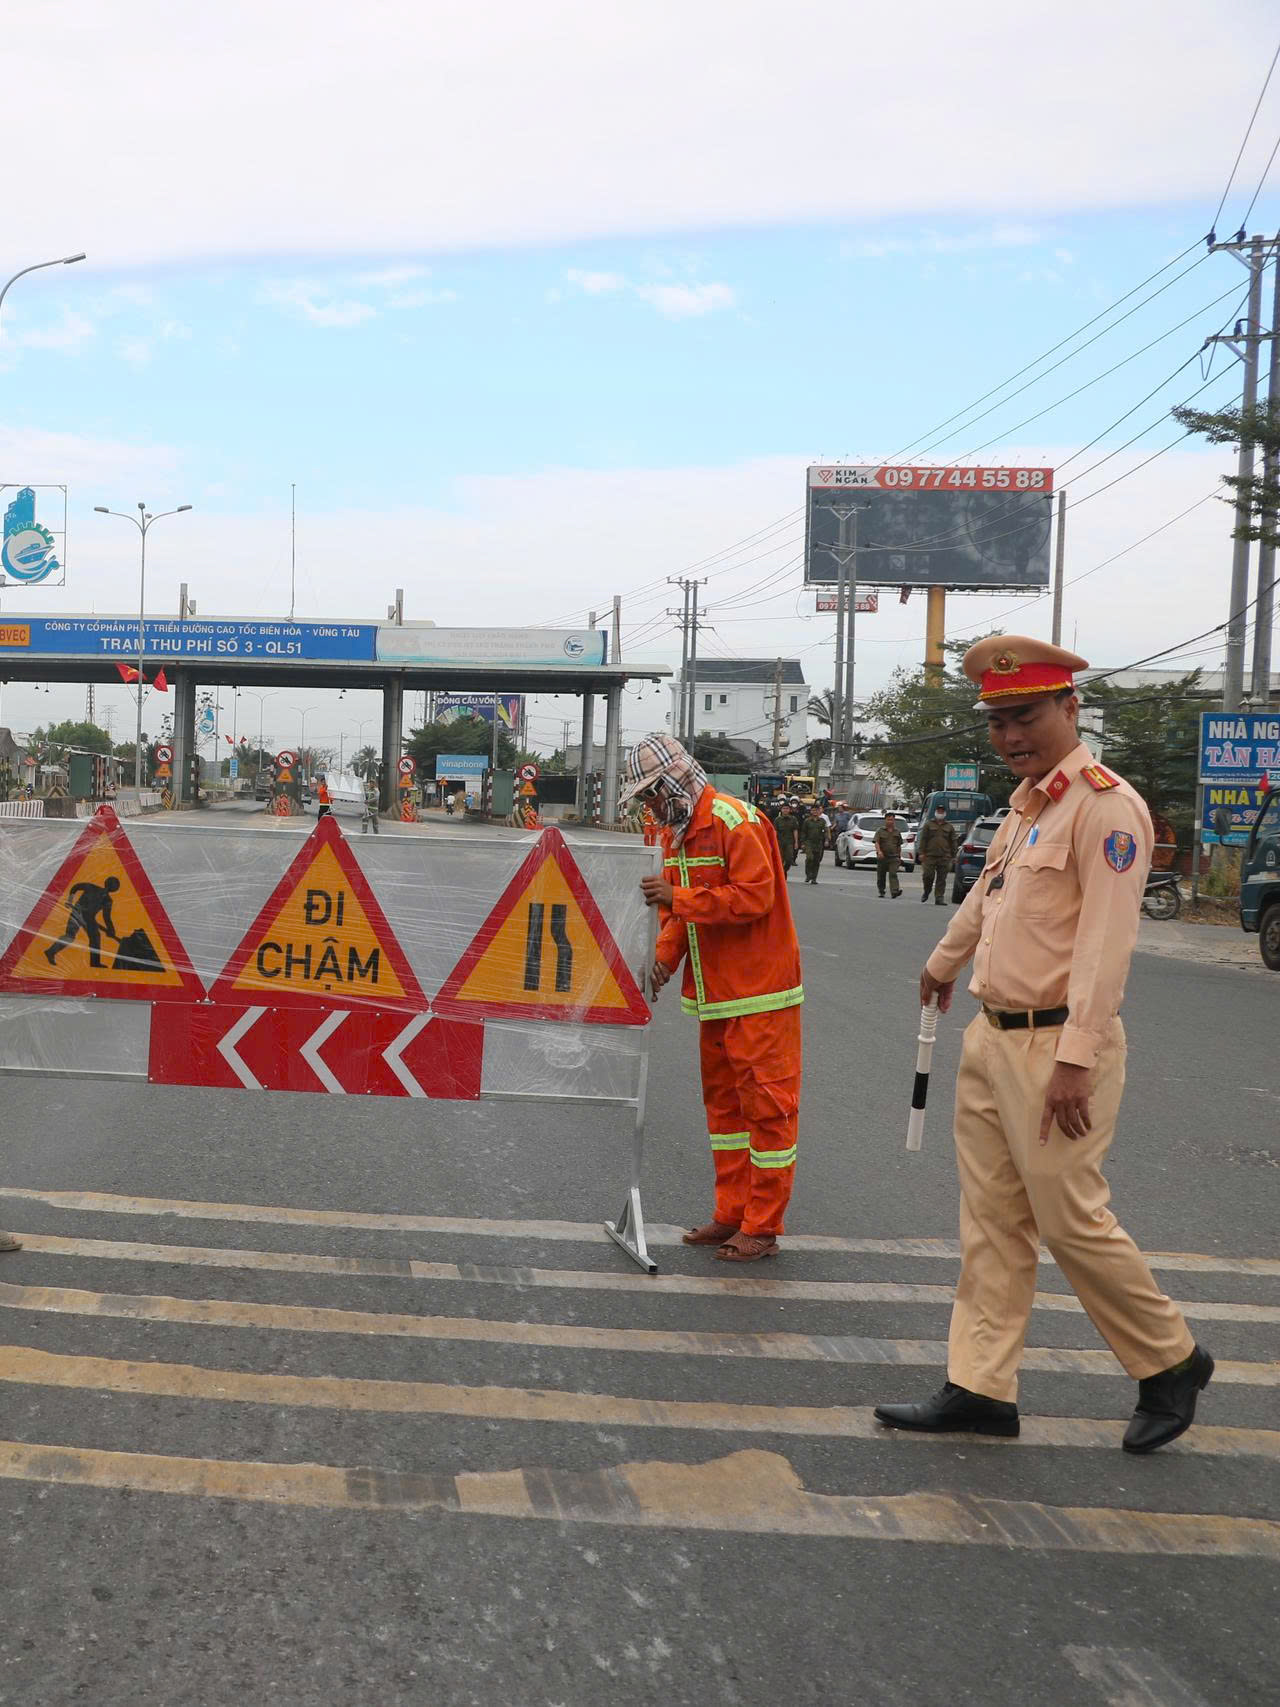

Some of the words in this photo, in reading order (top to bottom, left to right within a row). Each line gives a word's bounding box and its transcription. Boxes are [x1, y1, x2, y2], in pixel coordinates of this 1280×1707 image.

[884, 470, 913, 486] 09
[917, 470, 942, 487] 77
[948, 470, 976, 488] 44
[982, 470, 1010, 488] 55
[1016, 471, 1045, 488] 88
[0, 629, 26, 642] BVEC
[45, 622, 70, 631] CÔNG
[153, 621, 180, 633] TRIỂN
[182, 624, 214, 634] ĐƯỜNG
[217, 626, 235, 634] CAO
[239, 623, 257, 635] TỐC
[260, 625, 280, 636] BIÊN
[312, 626, 338, 637] VŨNG
[341, 627, 360, 638] TÀU
[101, 638, 146, 652] TRẠM
[151, 639, 182, 651] THU
[186, 637, 212, 652] PHÍ
[217, 637, 238, 653] SỐ
[244, 642, 253, 653] 3
[266, 642, 302, 654] QL51
[1208, 718, 1248, 739] NHÀ
[1205, 741, 1252, 768] TÂN
[1210, 787, 1250, 805] NHÀ
[304, 889, 345, 926] ĐI
[256, 936, 380, 991] CHẬM
